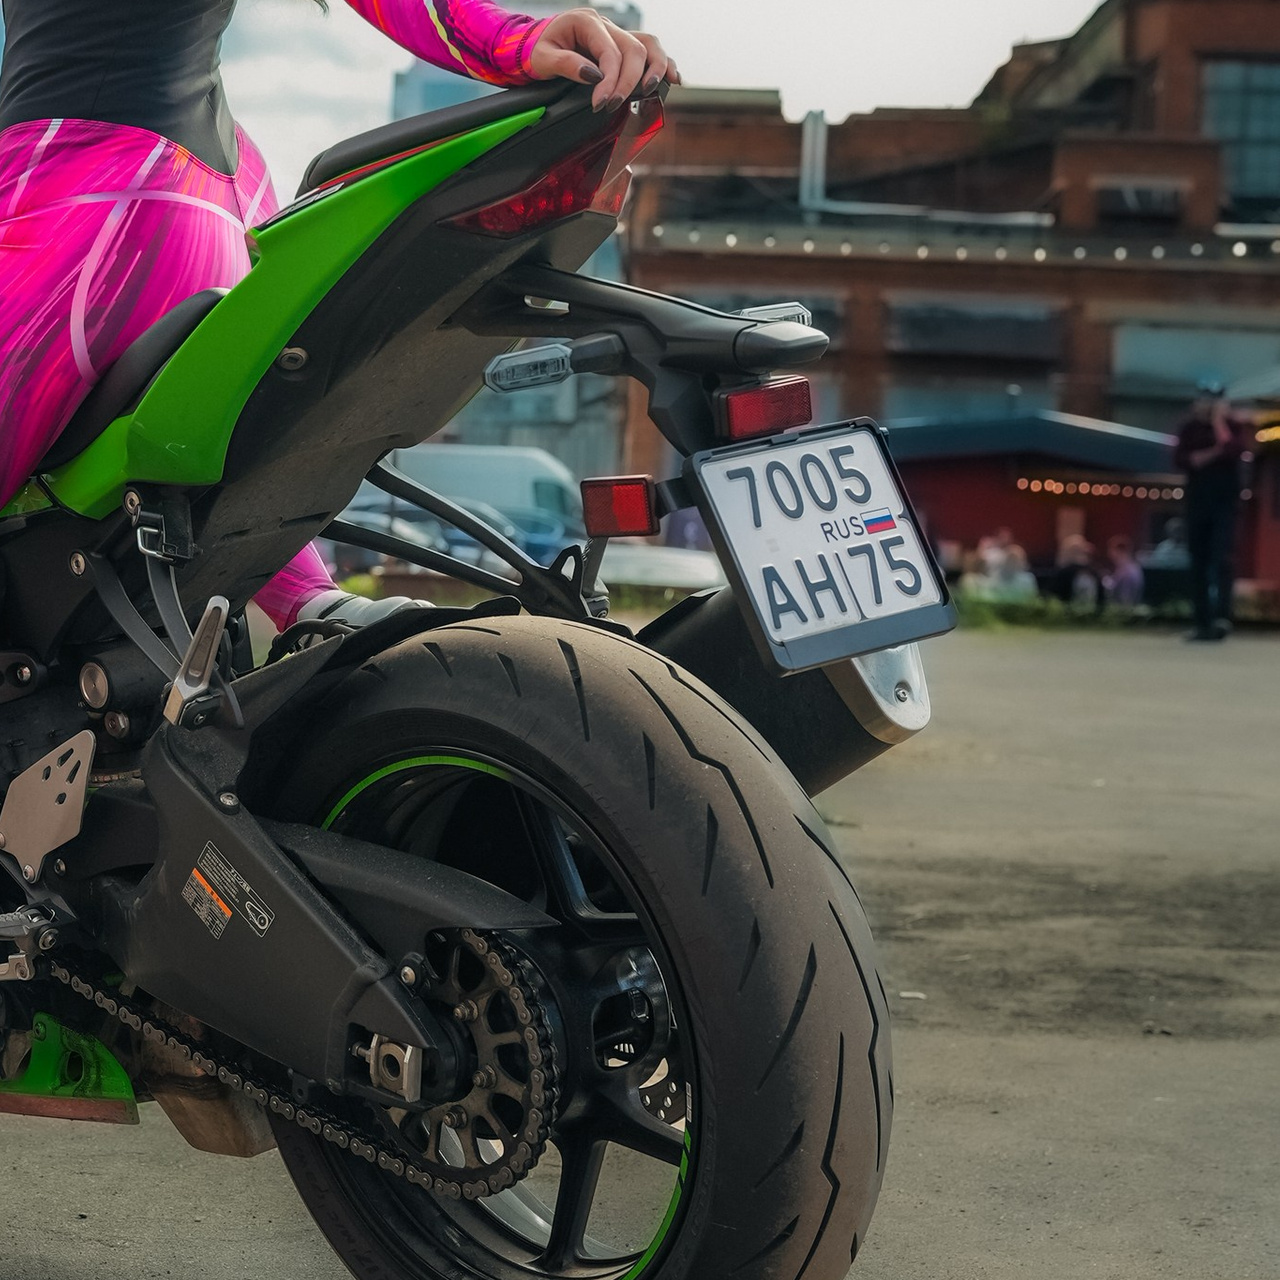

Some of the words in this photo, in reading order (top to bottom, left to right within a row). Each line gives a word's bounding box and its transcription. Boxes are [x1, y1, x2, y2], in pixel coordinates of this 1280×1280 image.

[726, 445, 872, 528] 7005
[820, 516, 865, 544] RUS
[847, 535, 922, 606] 75
